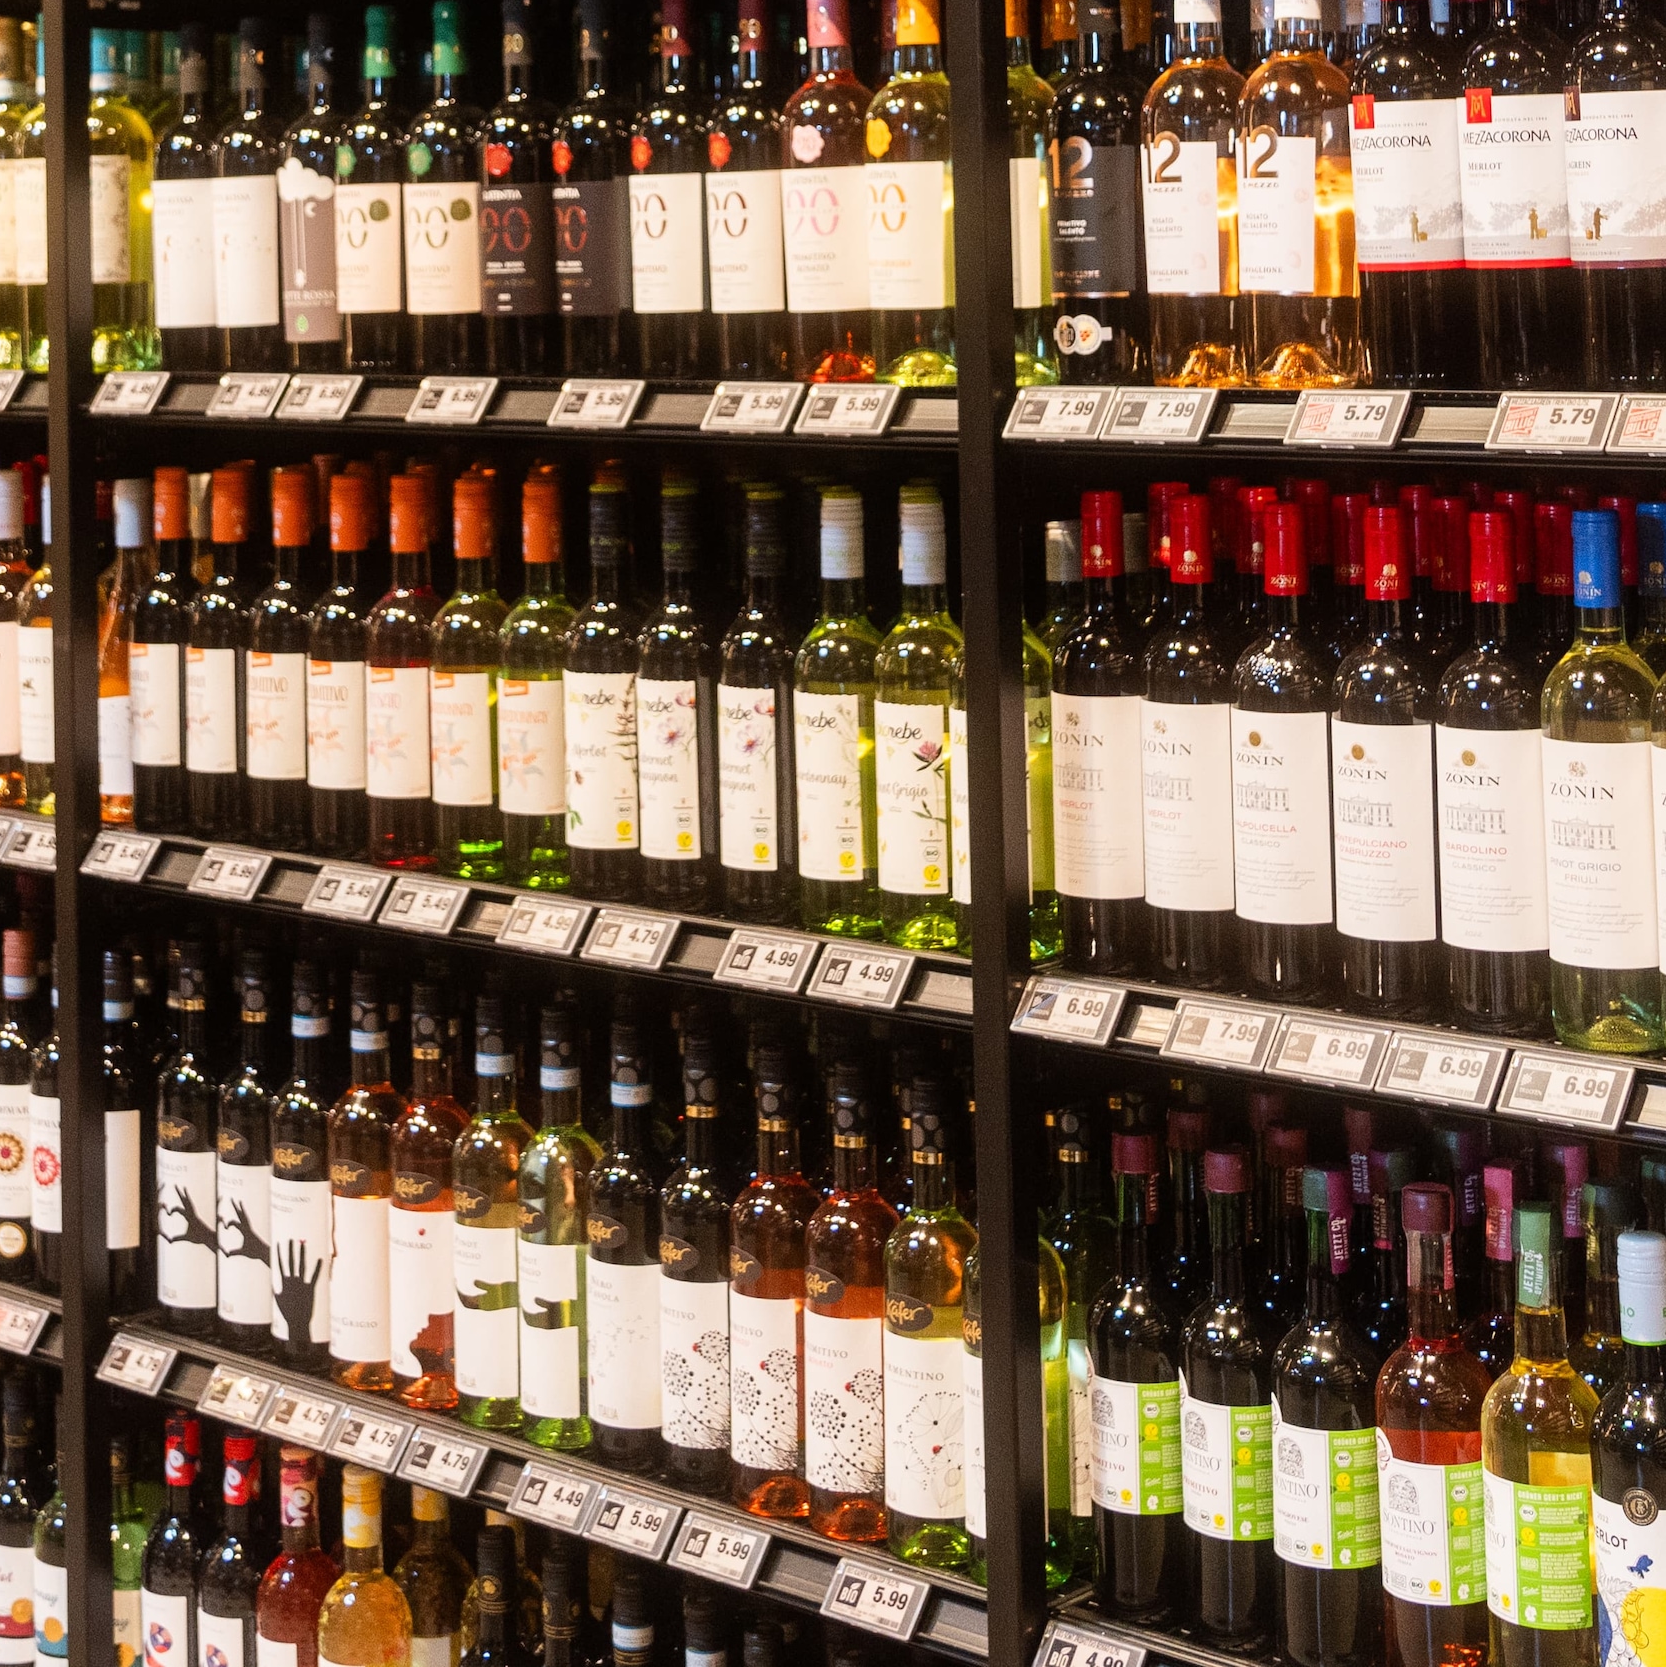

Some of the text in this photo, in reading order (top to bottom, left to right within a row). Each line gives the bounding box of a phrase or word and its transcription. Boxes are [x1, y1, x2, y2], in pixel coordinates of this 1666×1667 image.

[1462, 130, 1551, 145] MEZZACORONA
[1468, 160, 1502, 171] MERLOT
[751, 394, 783, 410] 5.99
[846, 395, 880, 413] 5.99
[1059, 400, 1095, 418] 7.99
[1159, 401, 1196, 418] 7.99
[1343, 404, 1387, 422] 5.79
[1549, 407, 1596, 426] 5.79
[1053, 732, 1105, 748] ZONIN
[1235, 751, 1284, 768] ZONIN
[1338, 765, 1388, 781] ZONIN
[1445, 773, 1501, 788] ZONIN
[1550, 784, 1616, 802] ZONIN
[1445, 841, 1508, 856] BARDOLINO
[1578, 859, 1622, 873] GRIGIO
[764, 949, 798, 968] 4.99
[859, 963, 894, 983] 4.99
[1066, 997, 1105, 1020] 6.99
[1221, 1021, 1260, 1044] 7.99
[1326, 1038, 1369, 1062] 6.99
[1439, 1055, 1483, 1080] 6.99
[1563, 1075, 1610, 1099] 6.99
[441, 1450, 471, 1472] 4.79
[553, 1486, 584, 1508] 4.49
[630, 1511, 662, 1534] 5.99
[716, 1535, 751, 1560] 5.99
[872, 1584, 908, 1611] 5.99
